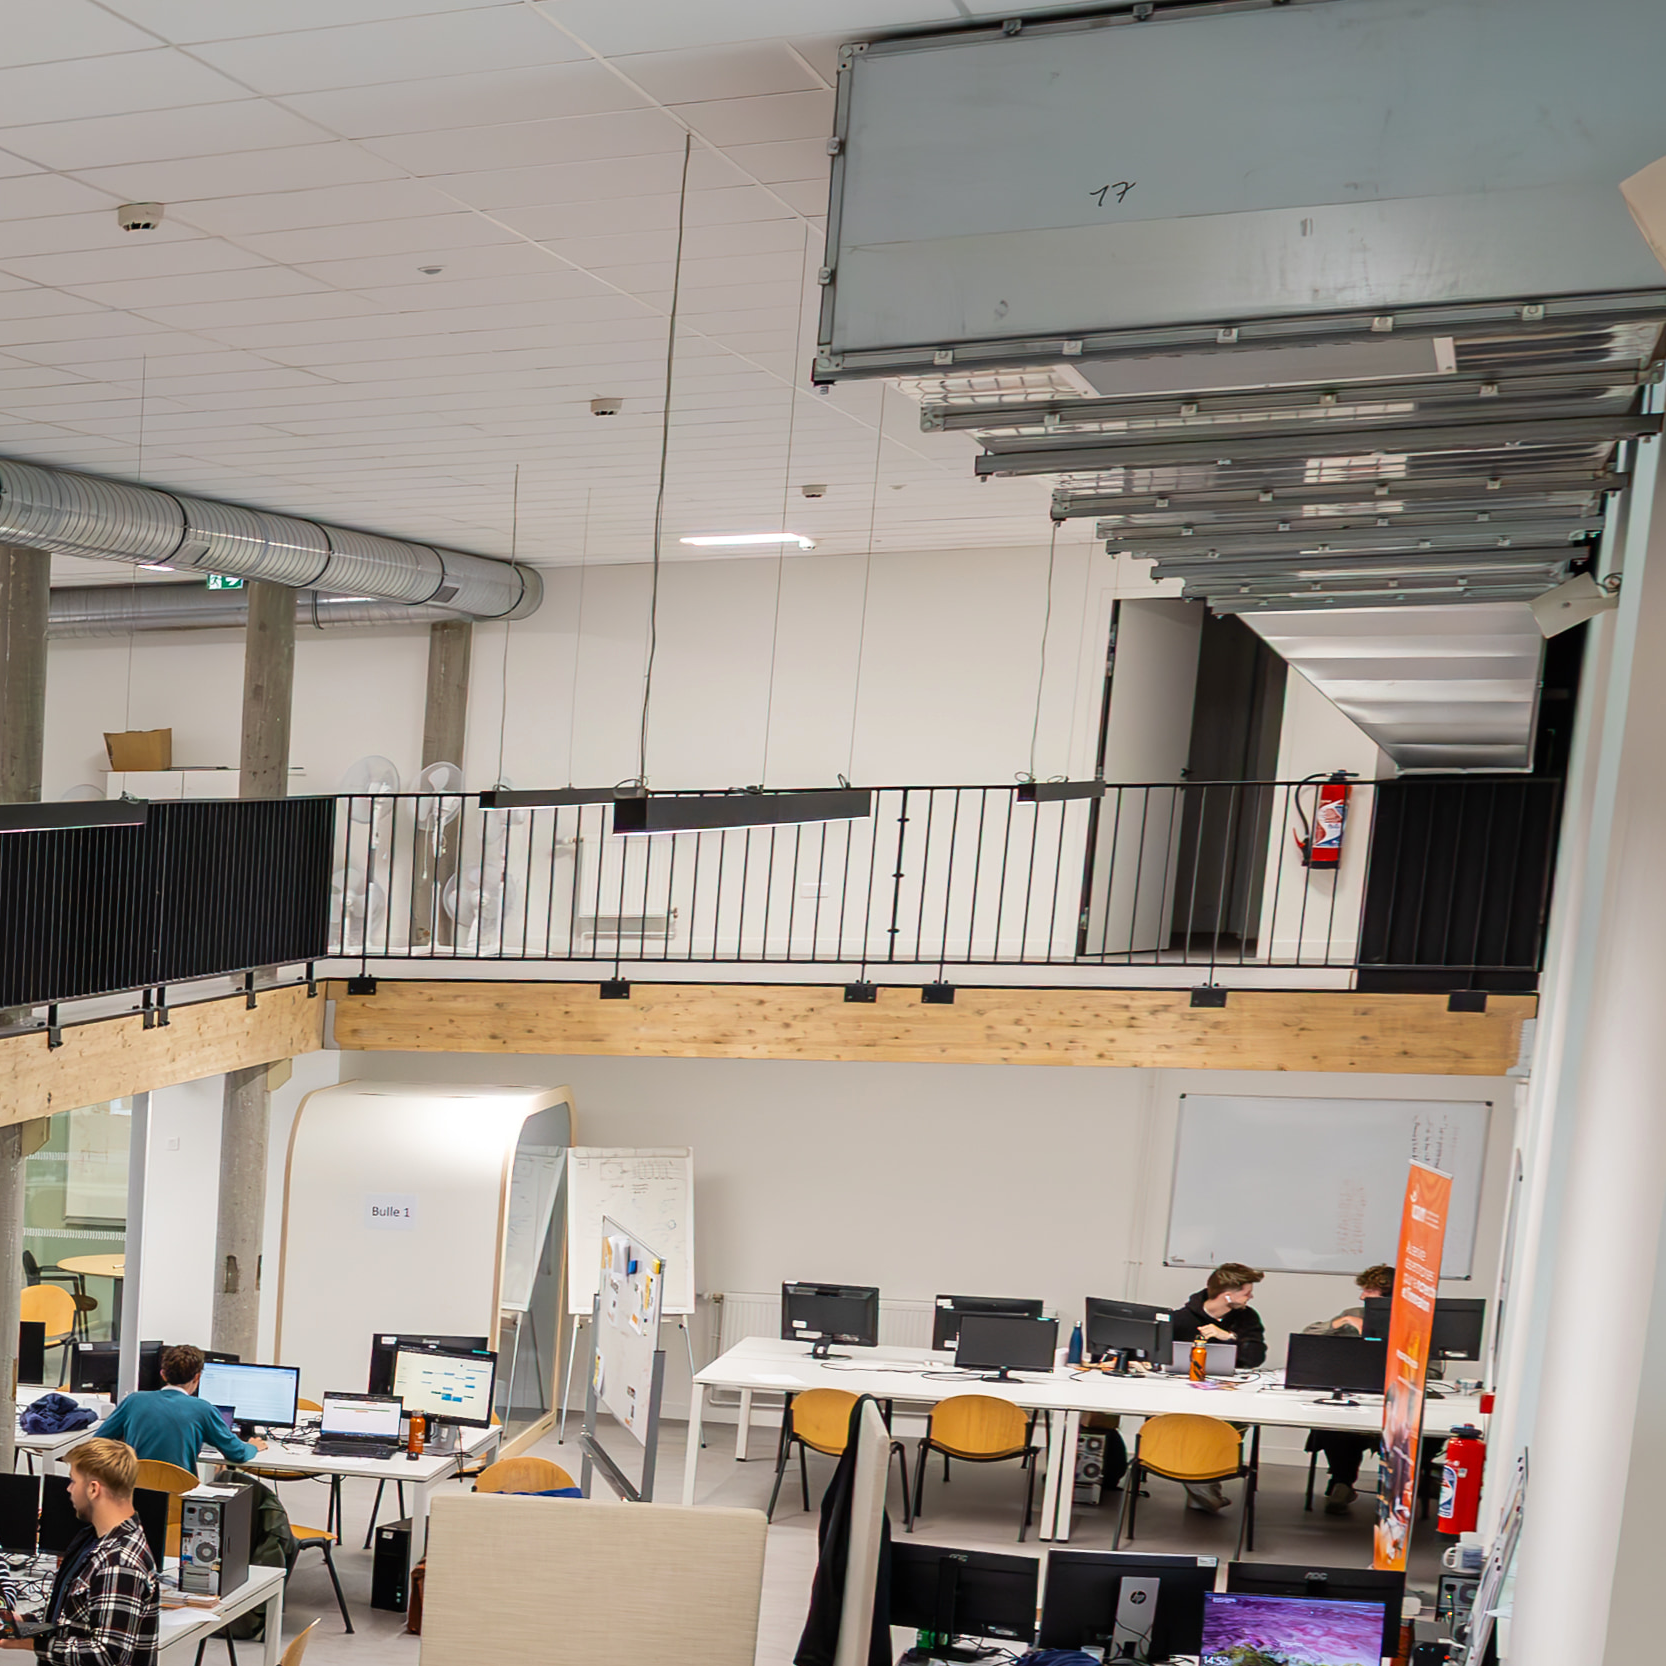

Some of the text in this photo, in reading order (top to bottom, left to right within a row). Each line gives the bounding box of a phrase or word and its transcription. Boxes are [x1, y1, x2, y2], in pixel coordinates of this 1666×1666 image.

[1089, 181, 1137, 207] 17
[372, 1206, 410, 1217] Bulle 1
